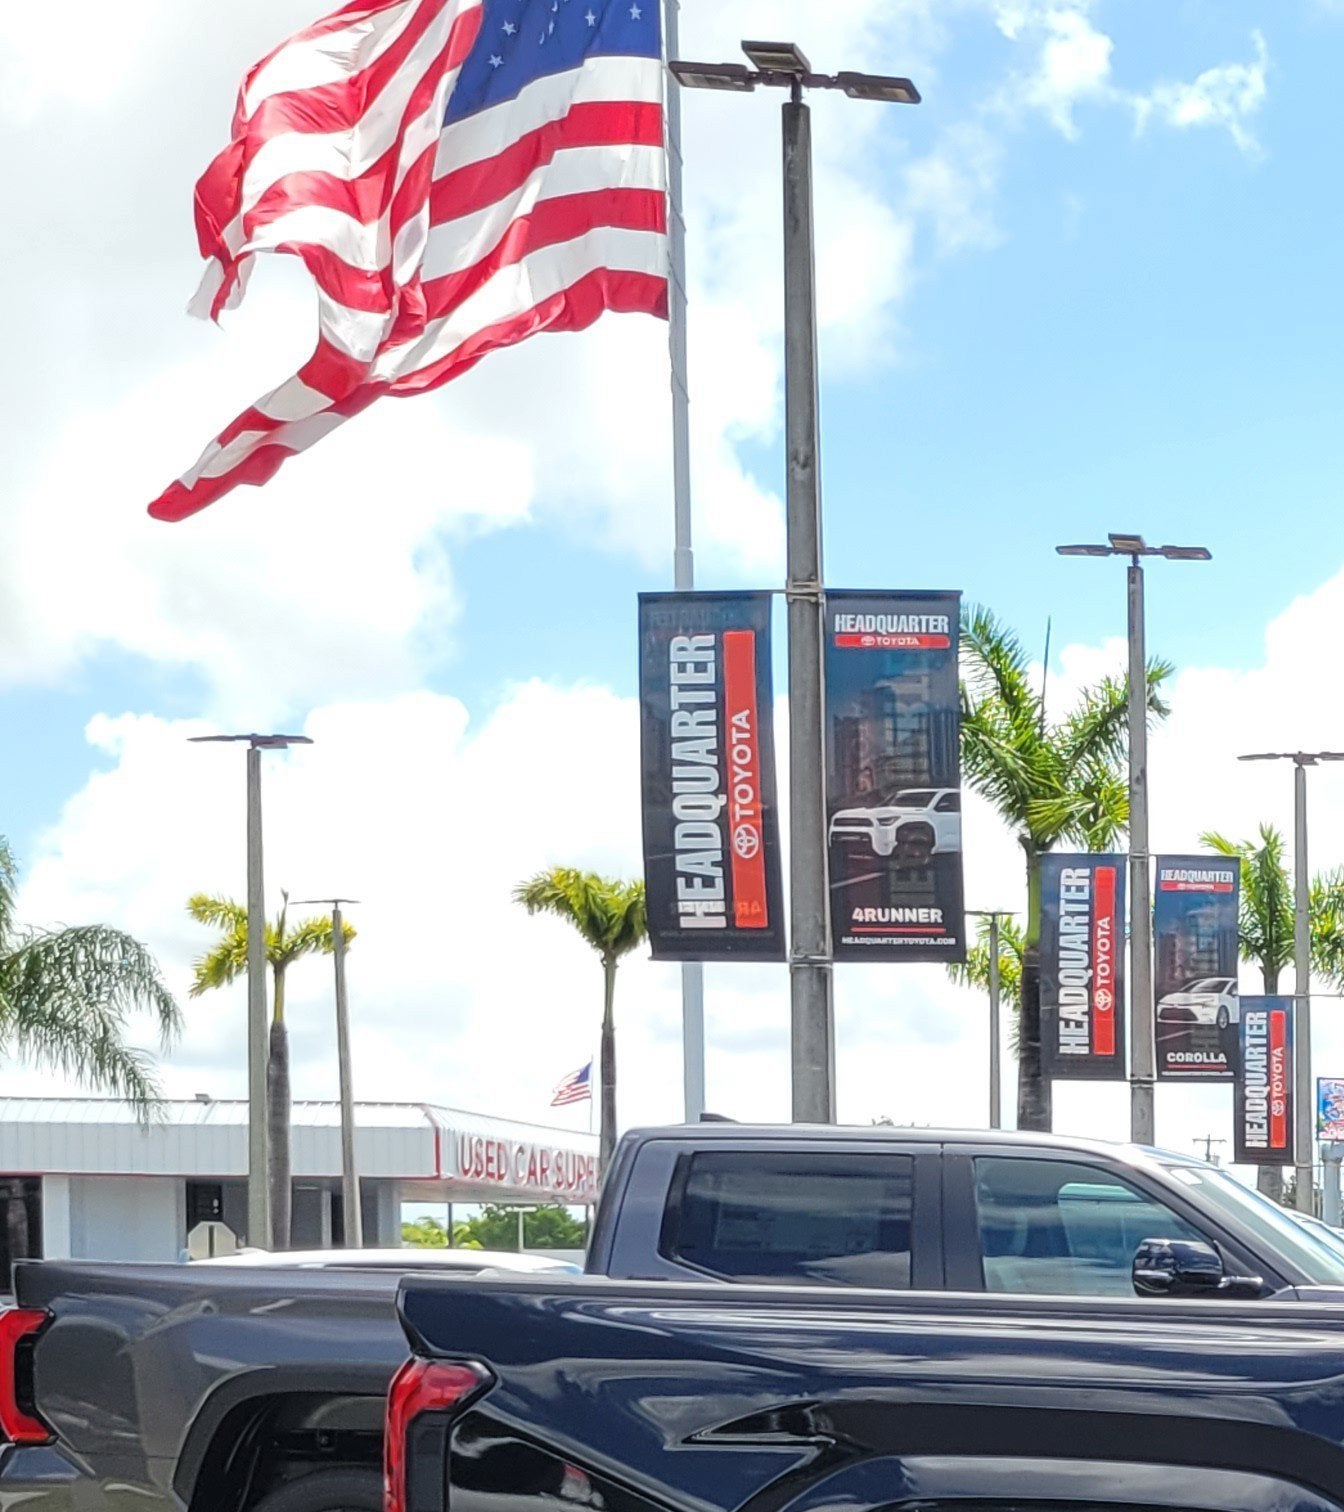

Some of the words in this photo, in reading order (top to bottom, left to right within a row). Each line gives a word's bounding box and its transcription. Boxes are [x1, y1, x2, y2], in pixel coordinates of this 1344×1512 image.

[834, 613, 949, 634] HEADQUARTER
[876, 636, 919, 646] TOYOTA
[669, 634, 727, 928] HEADQUARTER
[730, 709, 755, 820] TOYOTA
[1160, 869, 1233, 883] HEADQUARTER
[851, 907, 943, 923] 4RUNNER
[1057, 867, 1093, 1055] HEADQUARTER
[1096, 916, 1111, 986] TOYOTA
[1166, 1052, 1228, 1063] COROLLA
[1244, 1011, 1271, 1148] HEADQUARTER
[1272, 1047, 1284, 1098] TOYOTA
[459, 1134, 509, 1181] USED
[513, 1143, 550, 1187] CAR
[553, 1149, 601, 1192] SUPE
